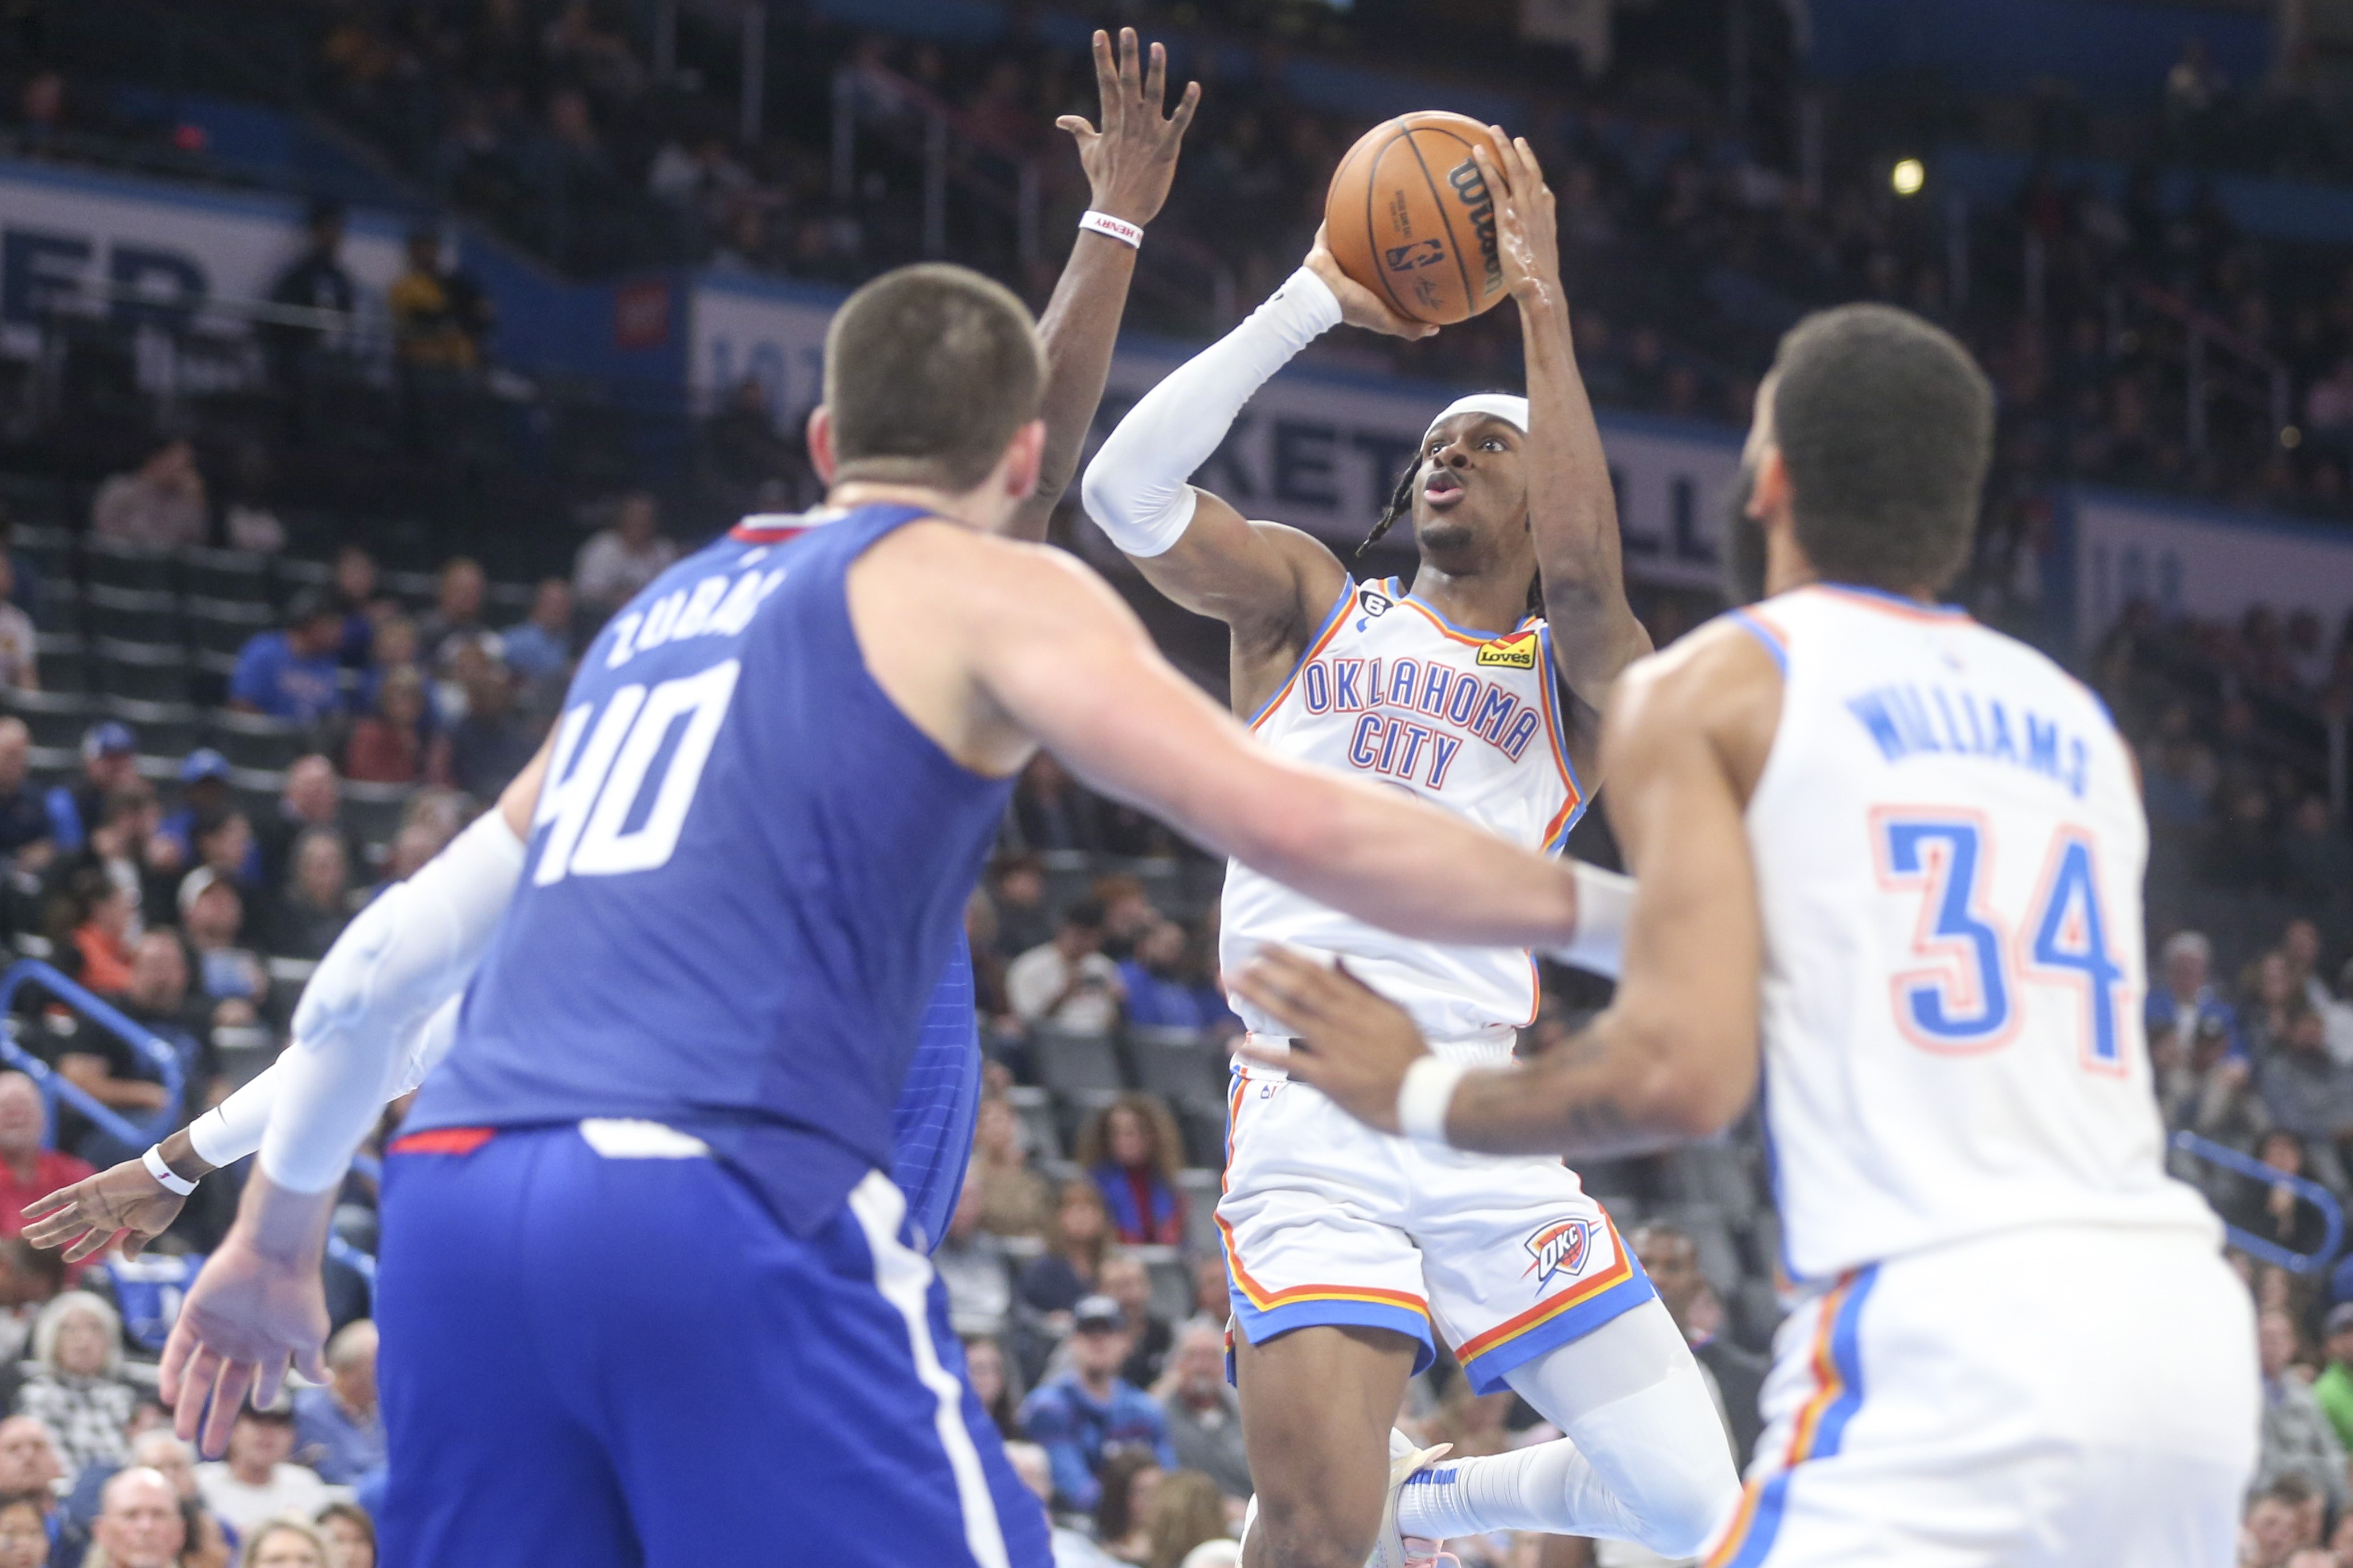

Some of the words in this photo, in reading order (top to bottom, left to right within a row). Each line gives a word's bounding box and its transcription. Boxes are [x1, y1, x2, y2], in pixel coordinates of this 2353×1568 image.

[1094, 217, 1135, 238] HENRY
[1364, 594, 1386, 616] 6
[1303, 657, 1541, 763] OKLAHOMA
[1348, 711, 1463, 791] CITY
[1845, 682, 2089, 799] WILLIAMS
[532, 658, 741, 888] 40
[1867, 802, 2133, 1080] 34
[1538, 1225, 1579, 1282] OKC
